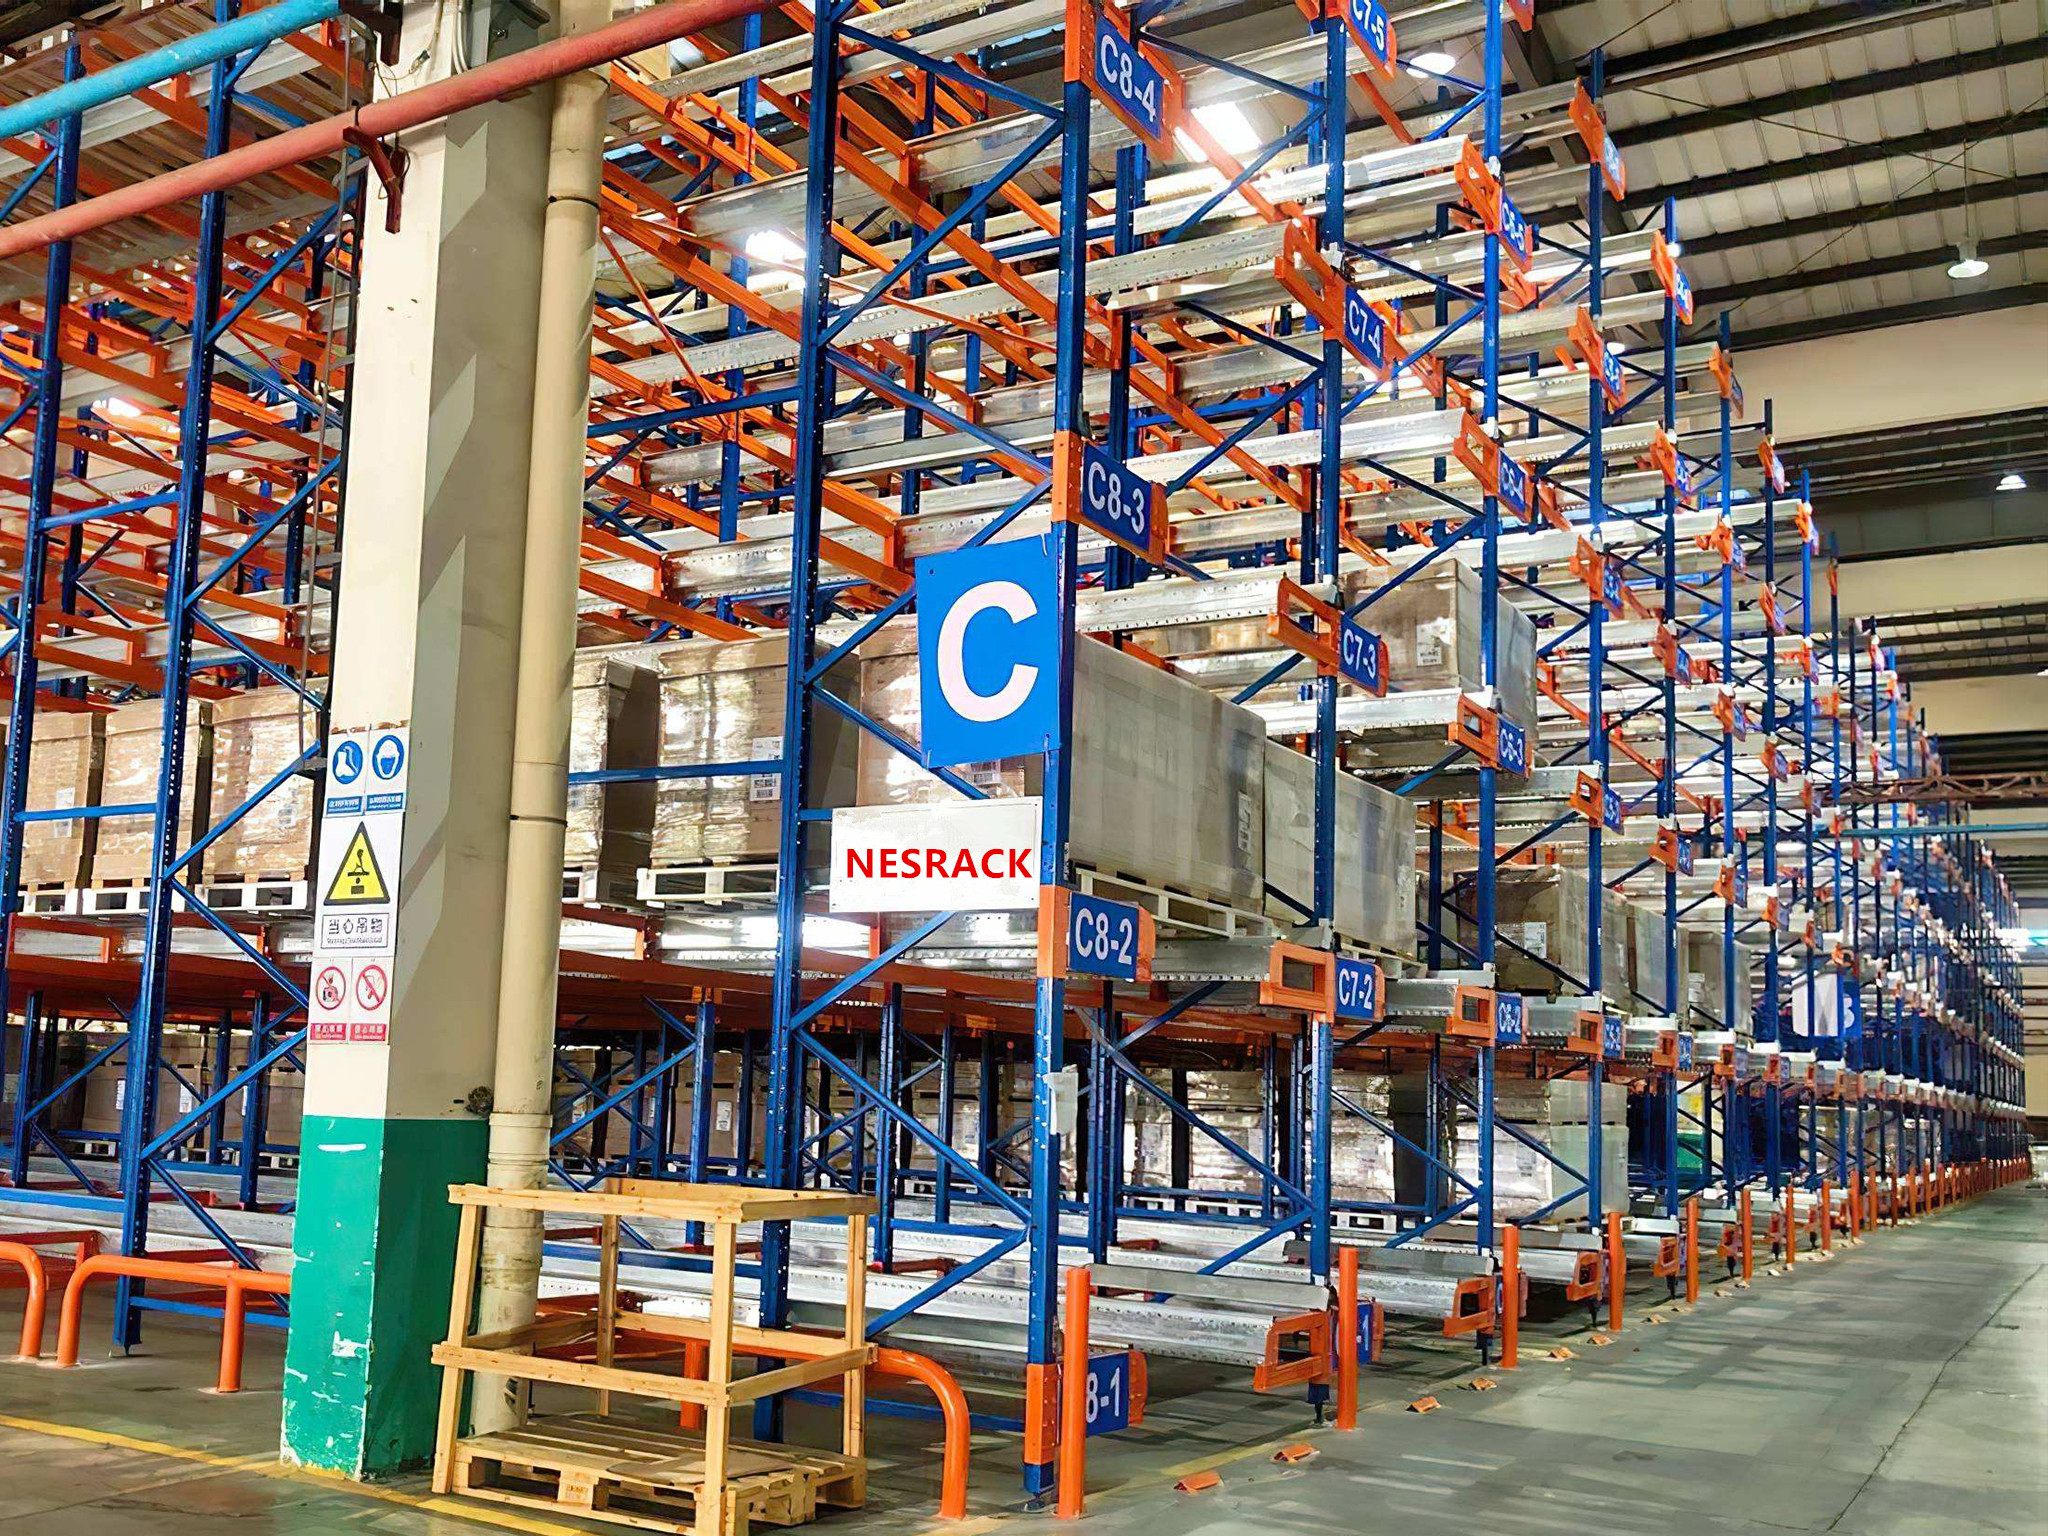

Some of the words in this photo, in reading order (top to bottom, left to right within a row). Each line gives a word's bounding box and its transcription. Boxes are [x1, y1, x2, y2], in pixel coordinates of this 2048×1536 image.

[1101, 34, 1156, 122] C8-4
[1348, 300, 1380, 359] C7-4
[1087, 461, 1145, 535] C8-3
[937, 580, 1039, 722] C
[1343, 628, 1376, 679] C7-3
[847, 848, 1033, 879] NESRACK
[1076, 908, 1133, 965] C8-2
[1339, 967, 1373, 1010] C7-2
[1086, 1366, 1120, 1424] 8-1
